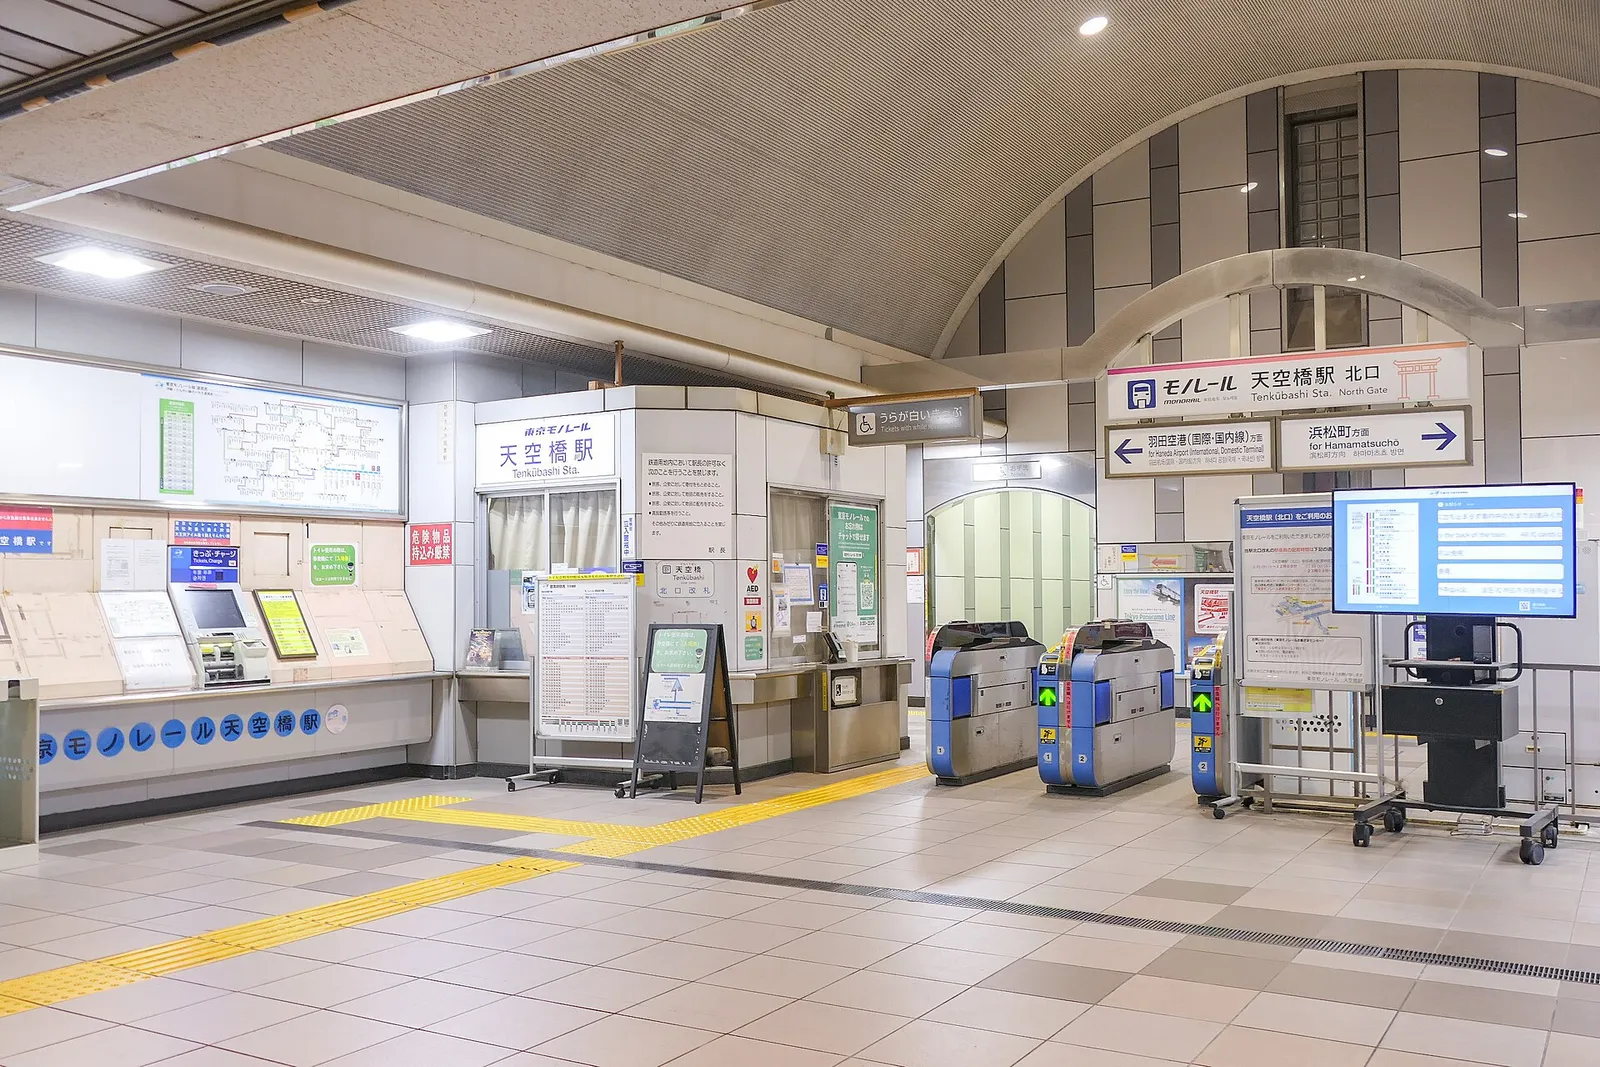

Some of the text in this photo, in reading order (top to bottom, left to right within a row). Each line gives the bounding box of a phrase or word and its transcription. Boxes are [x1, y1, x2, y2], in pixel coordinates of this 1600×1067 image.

[1251, 365, 1380, 389] 天空橋駅 北口
[1163, 375, 1238, 395] モノレール
[1251, 386, 1388, 402] Tenkūbashi Sta. North Gate
[524, 422, 592, 437] 東京モノレール
[1308, 425, 1370, 440] 浜松町方面
[500, 437, 593, 468] 天空橋駅
[1309, 442, 1322, 450] for
[512, 466, 580, 479] Tenkūbashi Sta.
[412, 528, 450, 544] 危険物品
[193, 550, 236, 558] きっぷ・チャージ
[412, 545, 450, 561] 持込み厳禁
[675, 565, 702, 574] 天空橋
